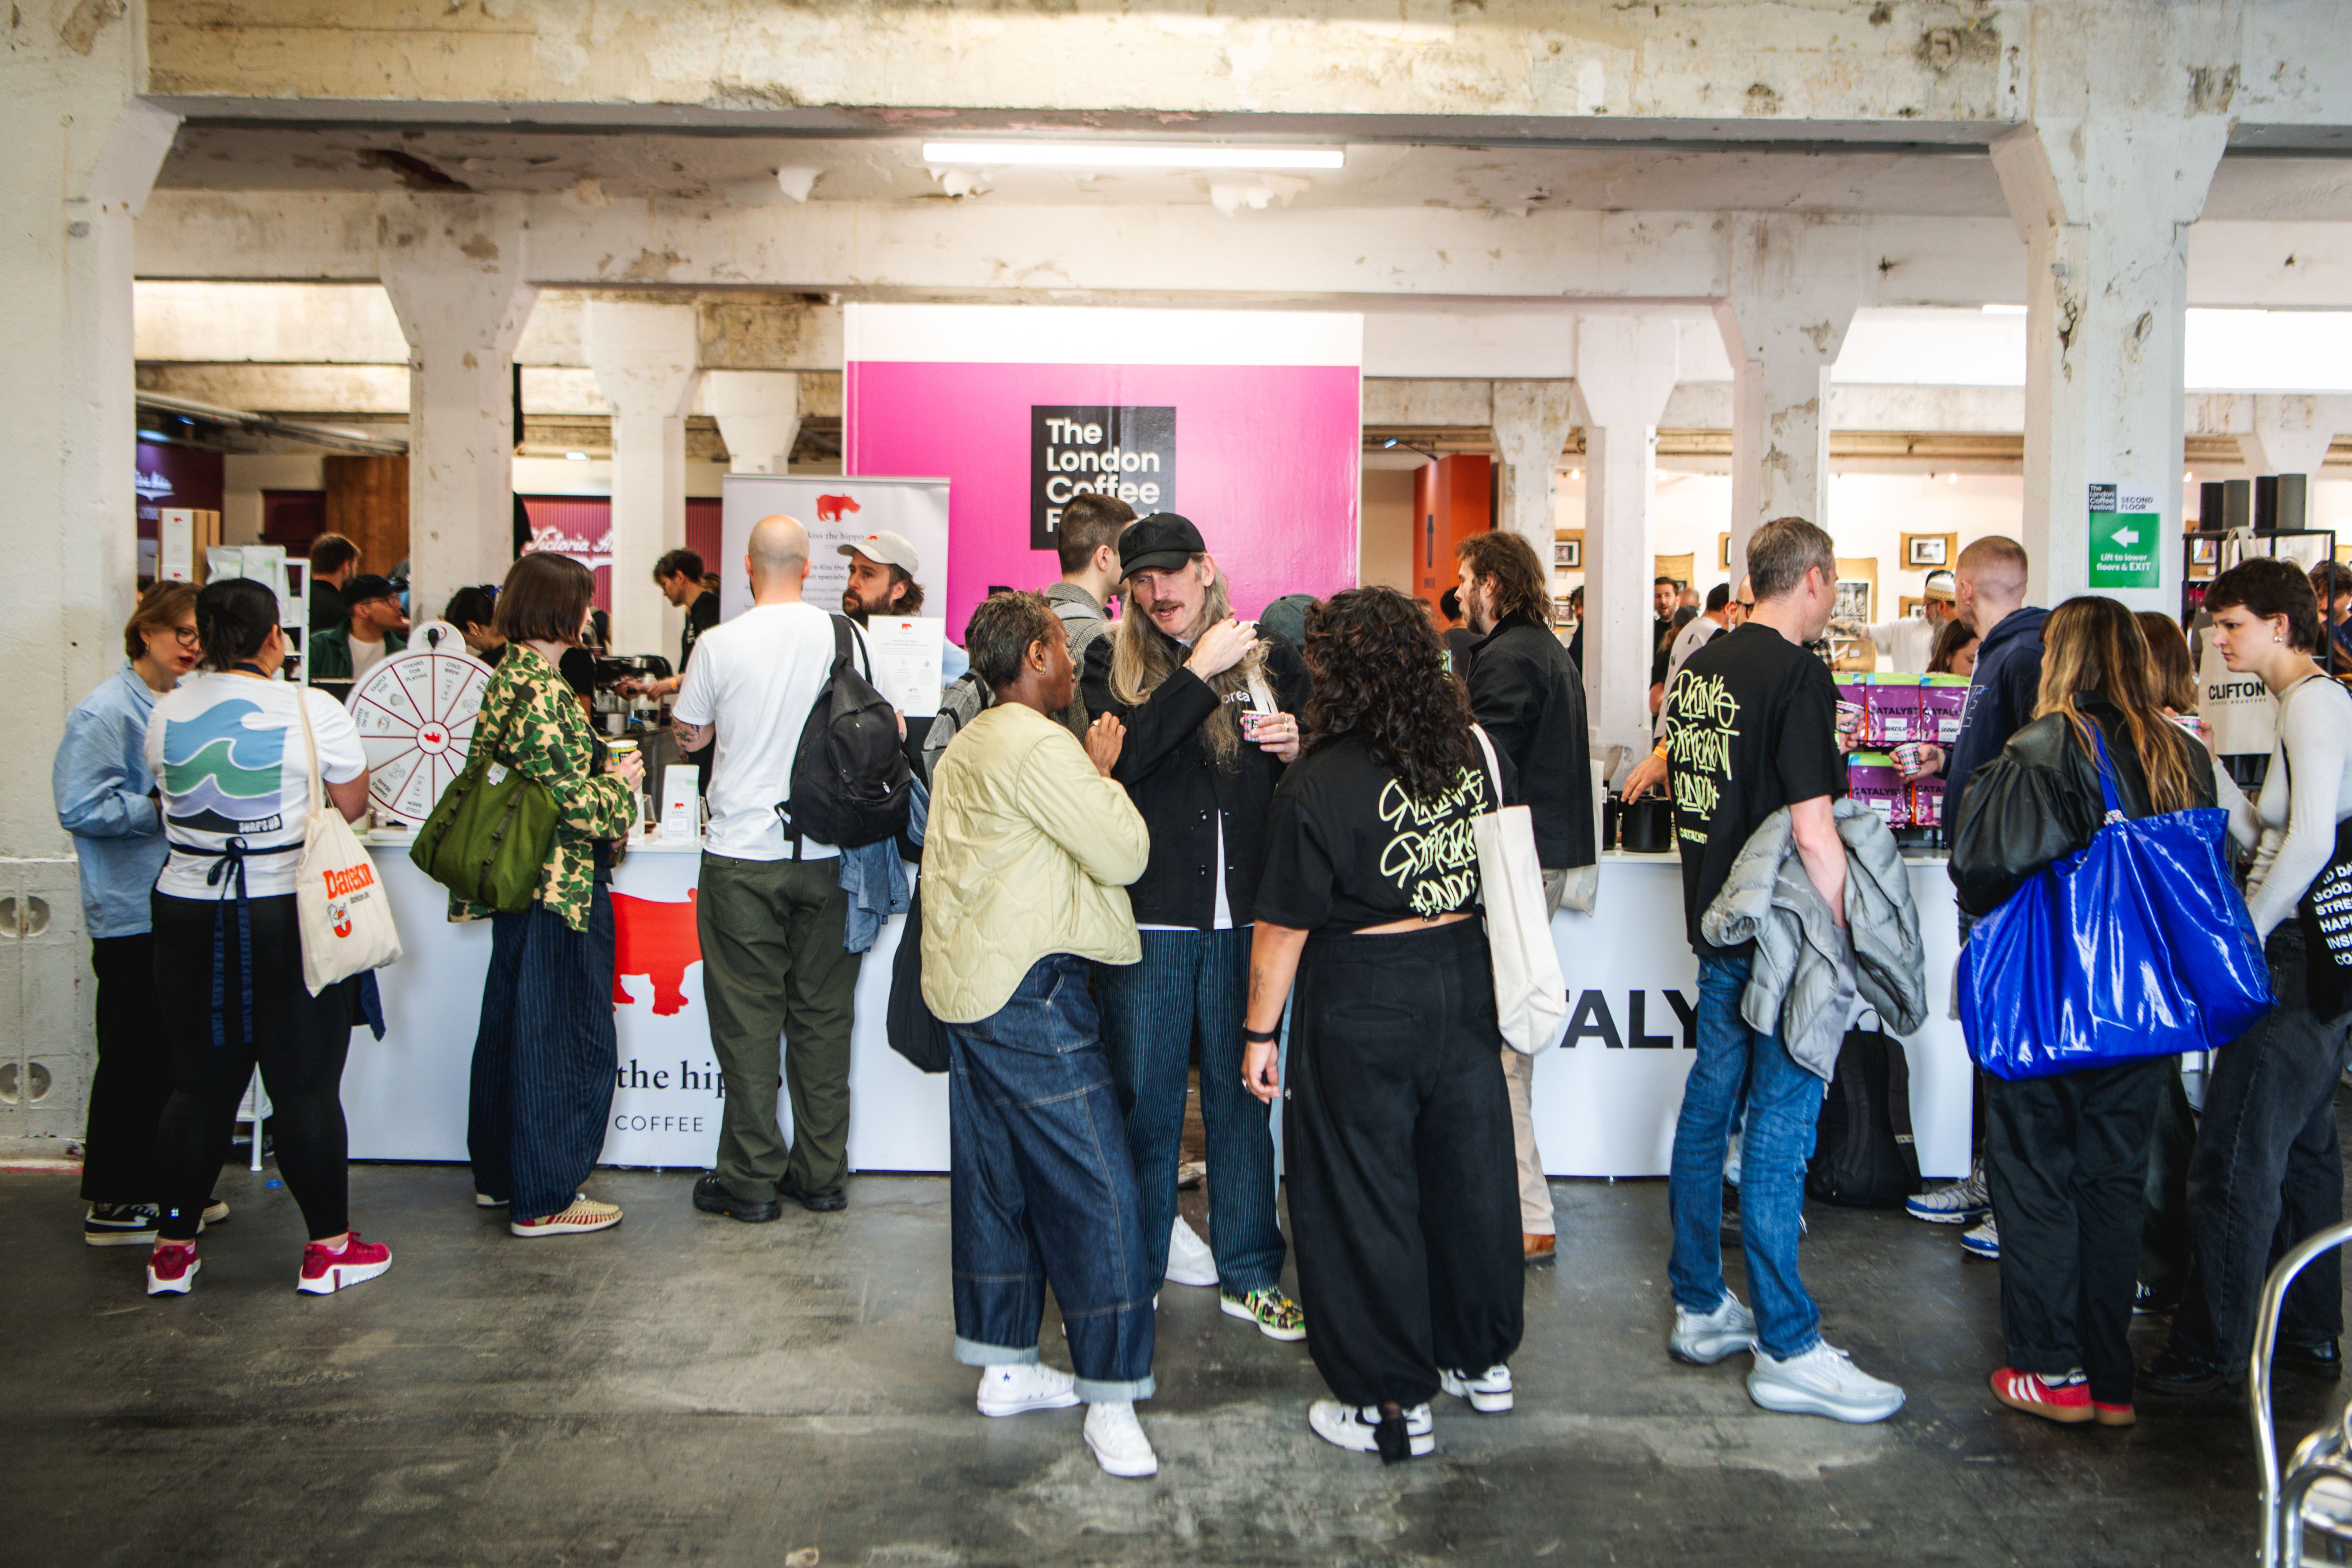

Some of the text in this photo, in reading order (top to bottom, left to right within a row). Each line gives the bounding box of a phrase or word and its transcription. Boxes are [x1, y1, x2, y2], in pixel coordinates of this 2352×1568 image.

[1045, 417, 1103, 445] The
[1046, 446, 1160, 472] London
[1046, 475, 1160, 505] Coffee
[524, 526, 590, 551] Victoria
[840, 532, 864, 542] hippo
[2129, 563, 2151, 571] EXIT
[402, 660, 424, 670] THANKS
[446, 661, 462, 670] COLD
[370, 675, 387, 692] SAMPLE
[405, 673, 428, 682] PLAYING
[378, 683, 389, 694] POD
[2208, 681, 2266, 700] CLIFTON
[355, 707, 365, 727] COFFEE
[1679, 827, 1708, 845] CATALYST
[2315, 898, 2352, 916] STRE
[1560, 989, 1699, 1049] ALY
[616, 1059, 670, 1089] the
[615, 1115, 704, 1132] COFFEE
